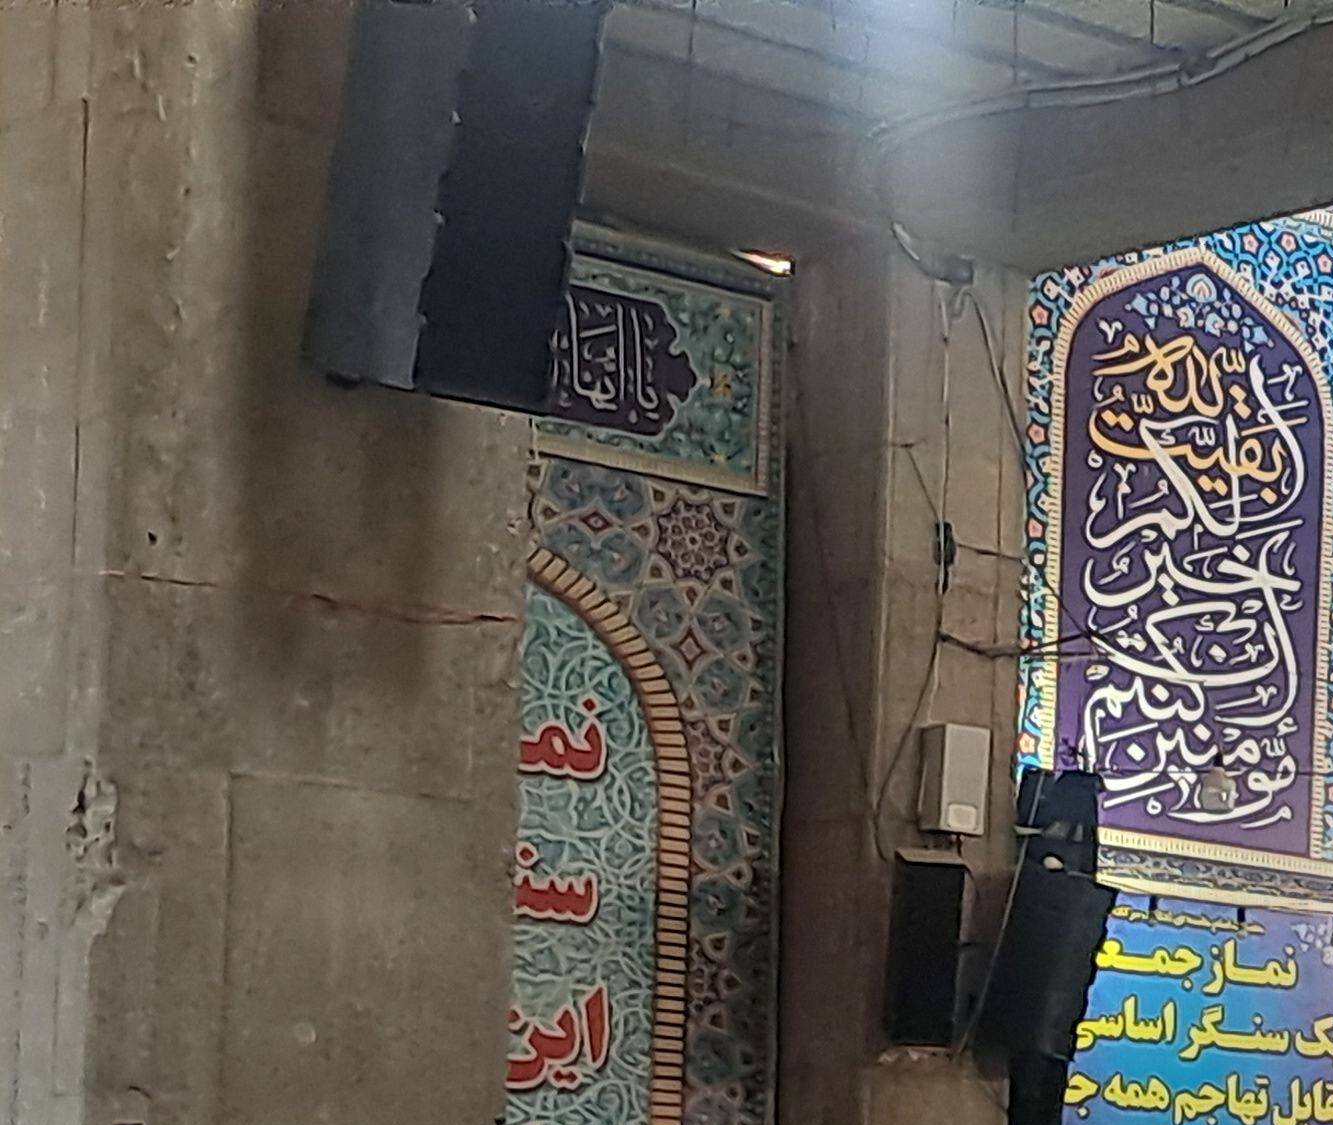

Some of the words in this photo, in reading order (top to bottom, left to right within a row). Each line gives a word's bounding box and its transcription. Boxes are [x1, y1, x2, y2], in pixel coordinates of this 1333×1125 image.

[1095, 939, 1203, 991] جمع
[1202, 938, 1299, 995] نماز
[1075, 995, 1177, 1050] اساسی
[1177, 1005, 1291, 1060] سنگر
[1102, 1072, 1171, 1112] همه
